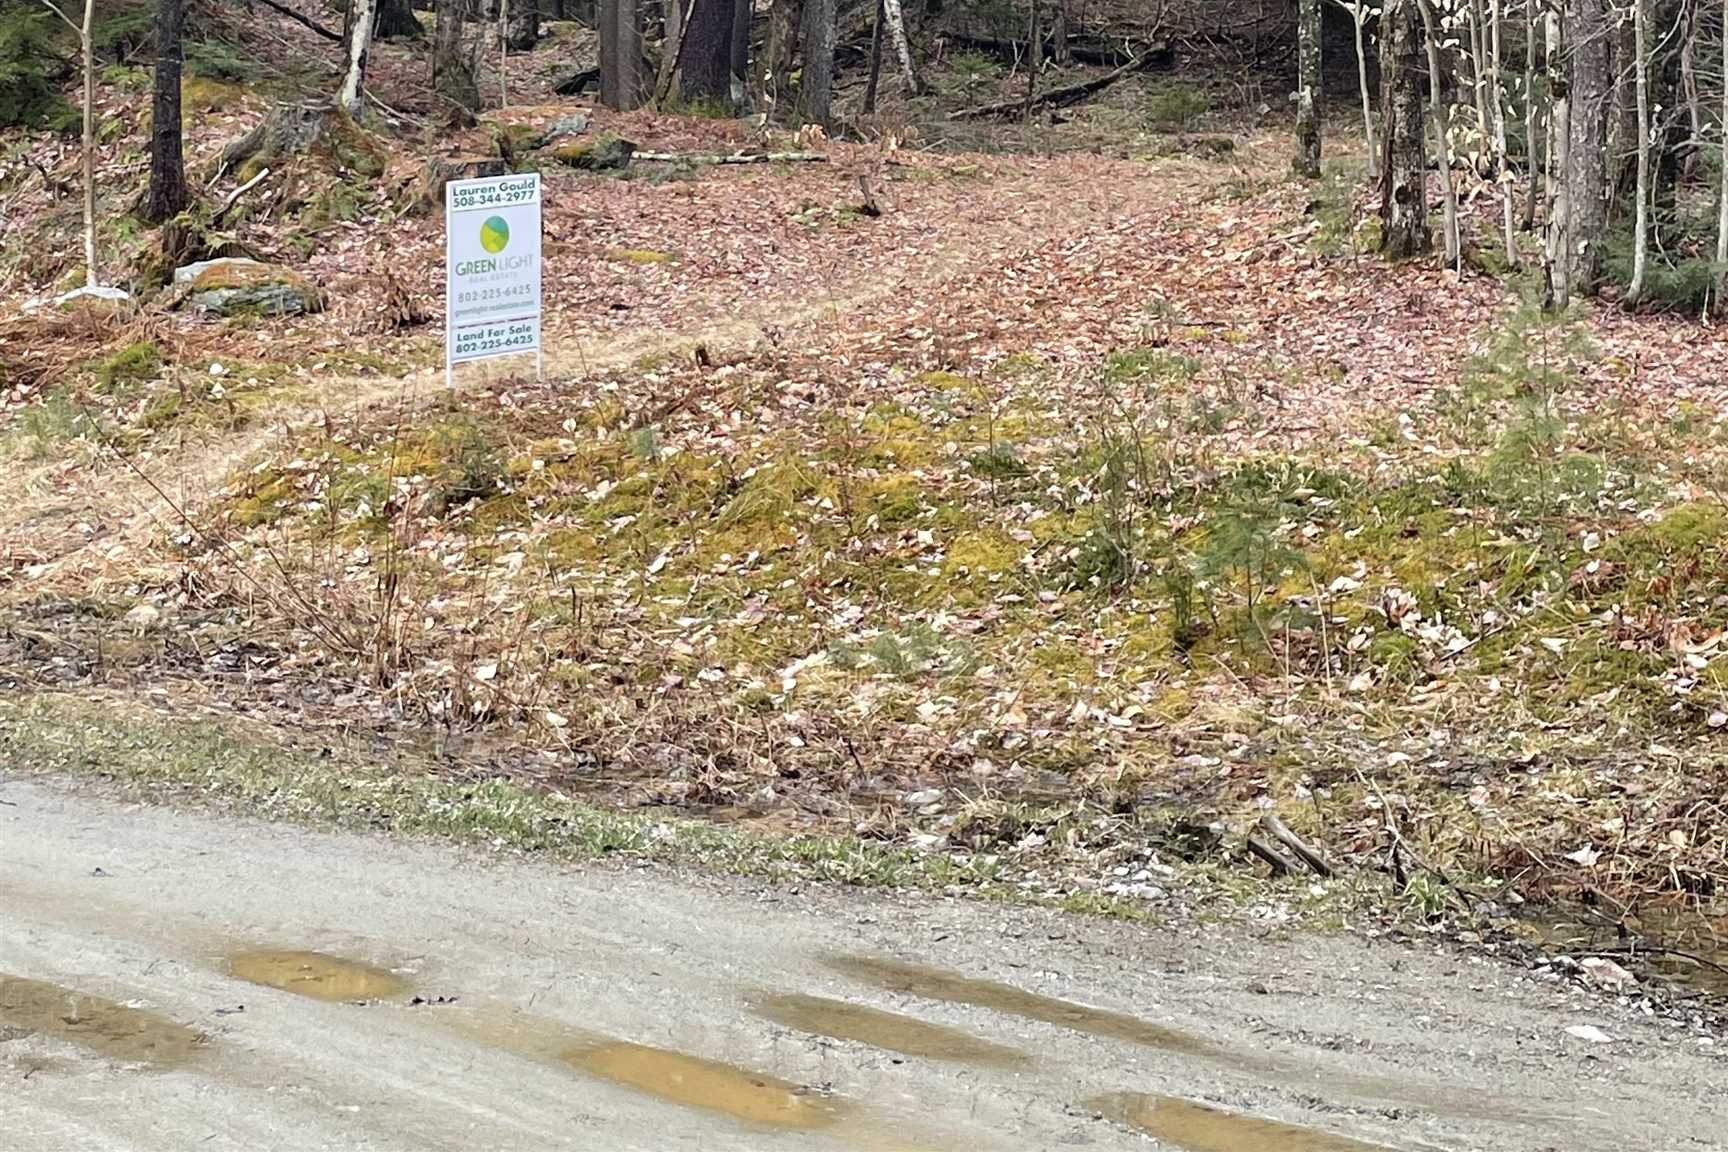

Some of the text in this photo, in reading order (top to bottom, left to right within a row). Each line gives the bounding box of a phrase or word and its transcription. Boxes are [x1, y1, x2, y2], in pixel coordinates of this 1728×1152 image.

[453, 179, 535, 197] Lauren Gould
[453, 190, 535, 208] 508-344-2977
[455, 254, 533, 276] GREEN LIGHT
[458, 284, 531, 303] 802-225-6425
[457, 324, 532, 342] Land For Sale
[456, 334, 533, 353] 802-225-6425
